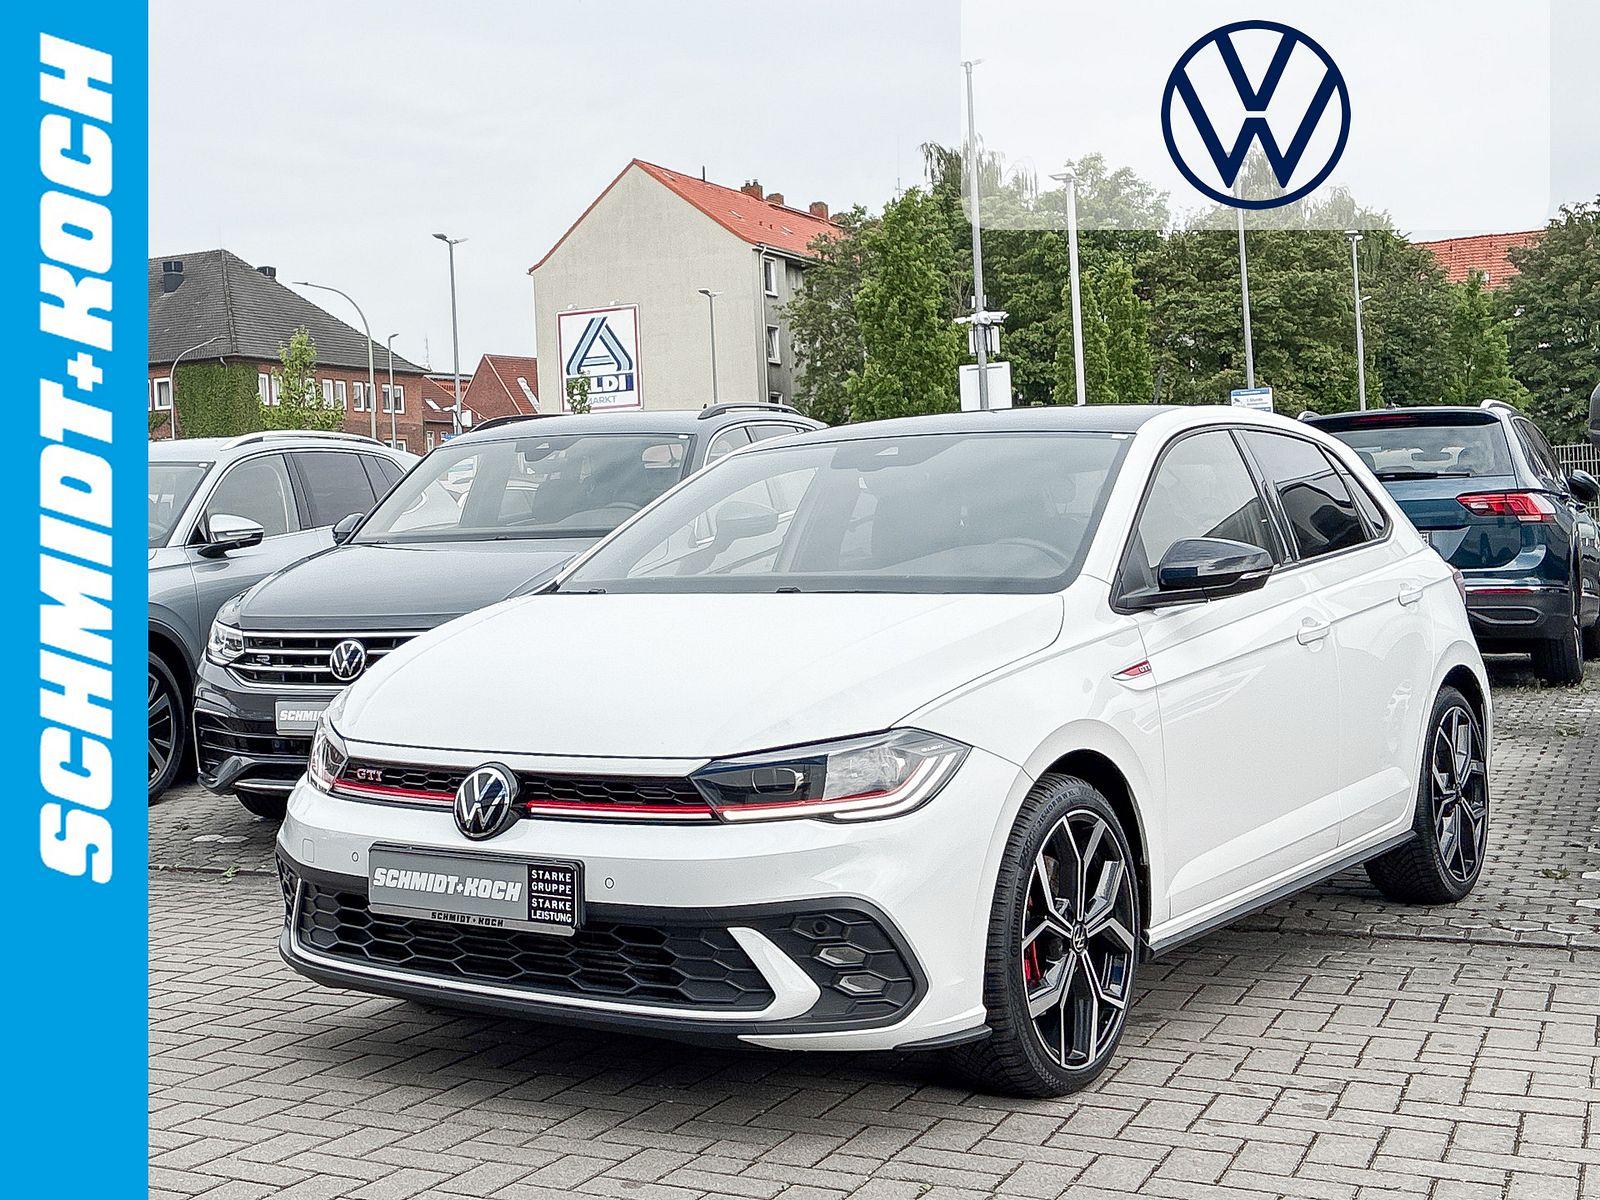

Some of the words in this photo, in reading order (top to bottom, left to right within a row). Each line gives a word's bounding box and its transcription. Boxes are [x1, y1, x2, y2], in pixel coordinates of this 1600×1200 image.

[573, 374, 627, 393] LDI
[356, 768, 383, 782] GTI
[531, 869, 572, 883] STARKE
[373, 867, 522, 902] SCHMIDT+KOCH
[531, 881, 572, 895] GRUPPE
[531, 898, 572, 911] STARKE
[531, 909, 572, 923] LEISTUNG
